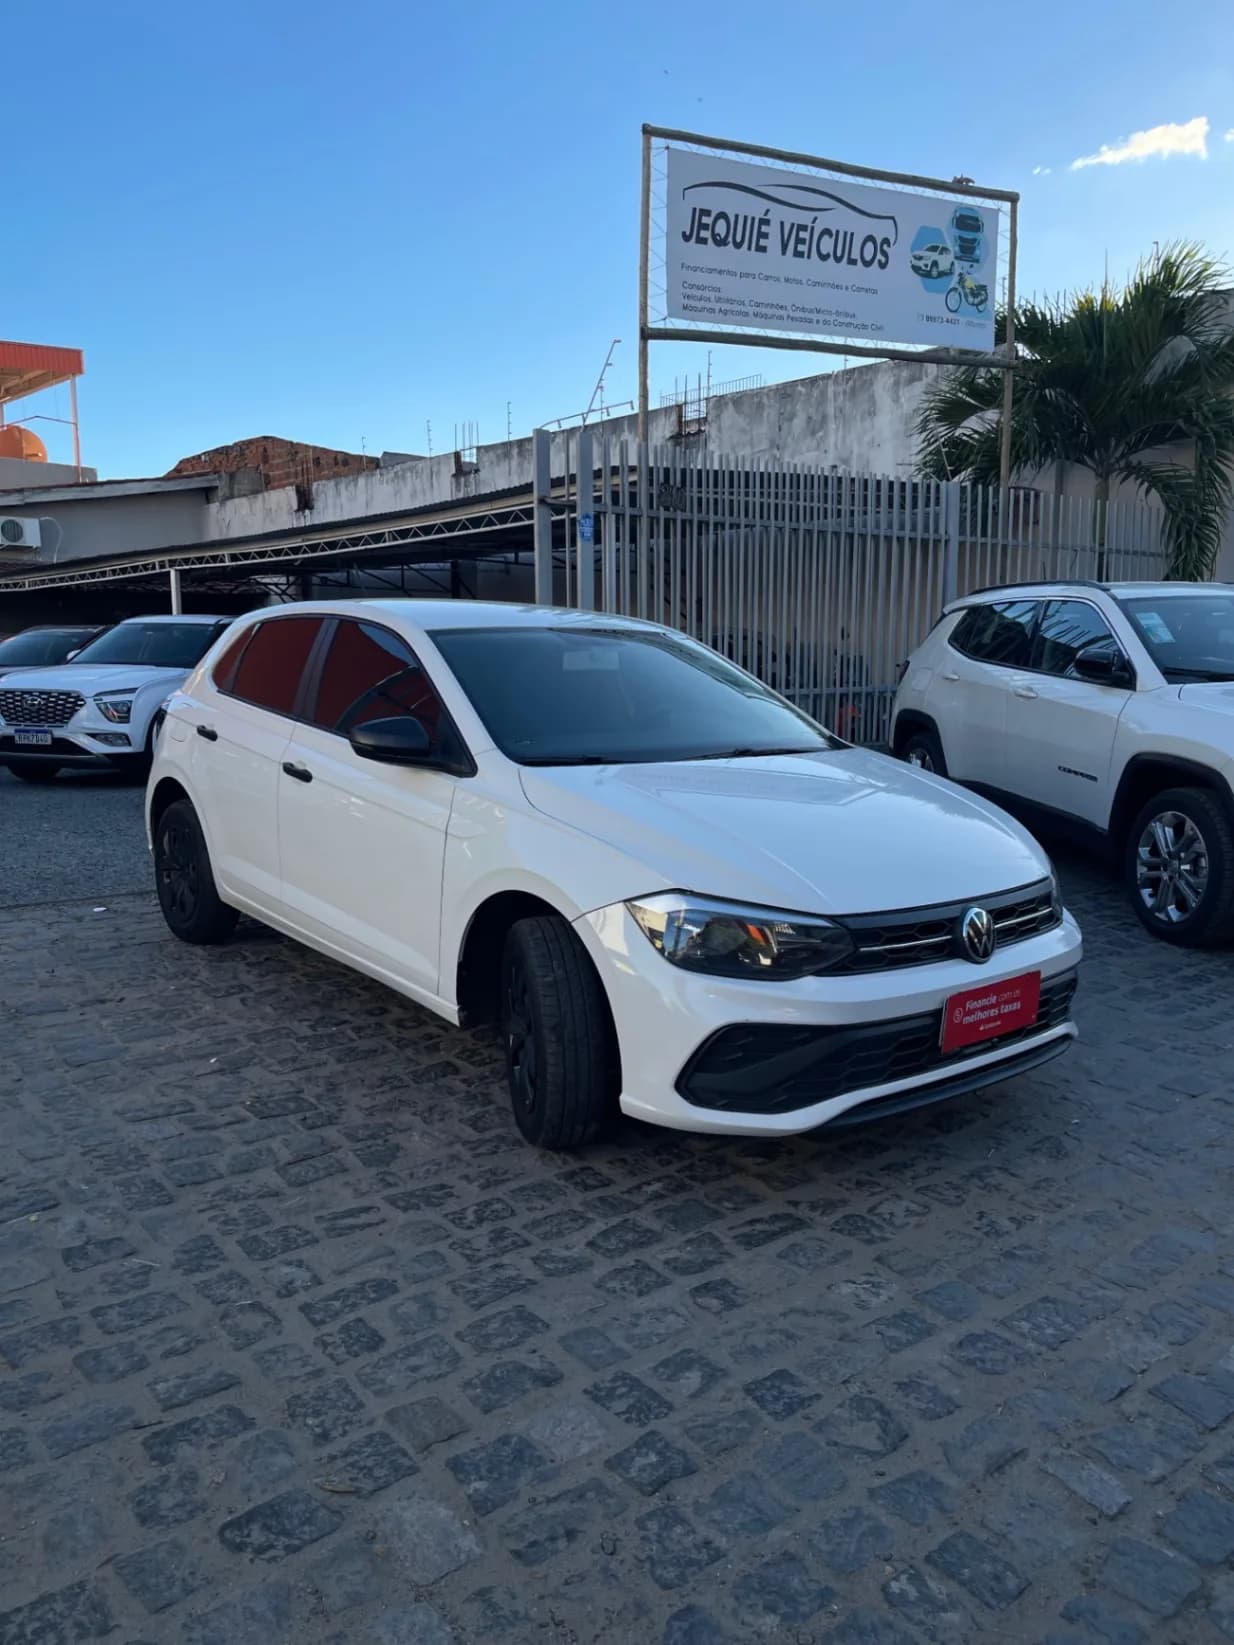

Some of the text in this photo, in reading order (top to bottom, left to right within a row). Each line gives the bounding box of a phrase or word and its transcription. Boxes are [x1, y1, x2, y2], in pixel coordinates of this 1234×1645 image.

[682, 207, 891, 270] JEQUIÉ VEÍCULOS
[739, 272, 756, 281] para
[962, 1000, 1021, 1025] melhores taxas
